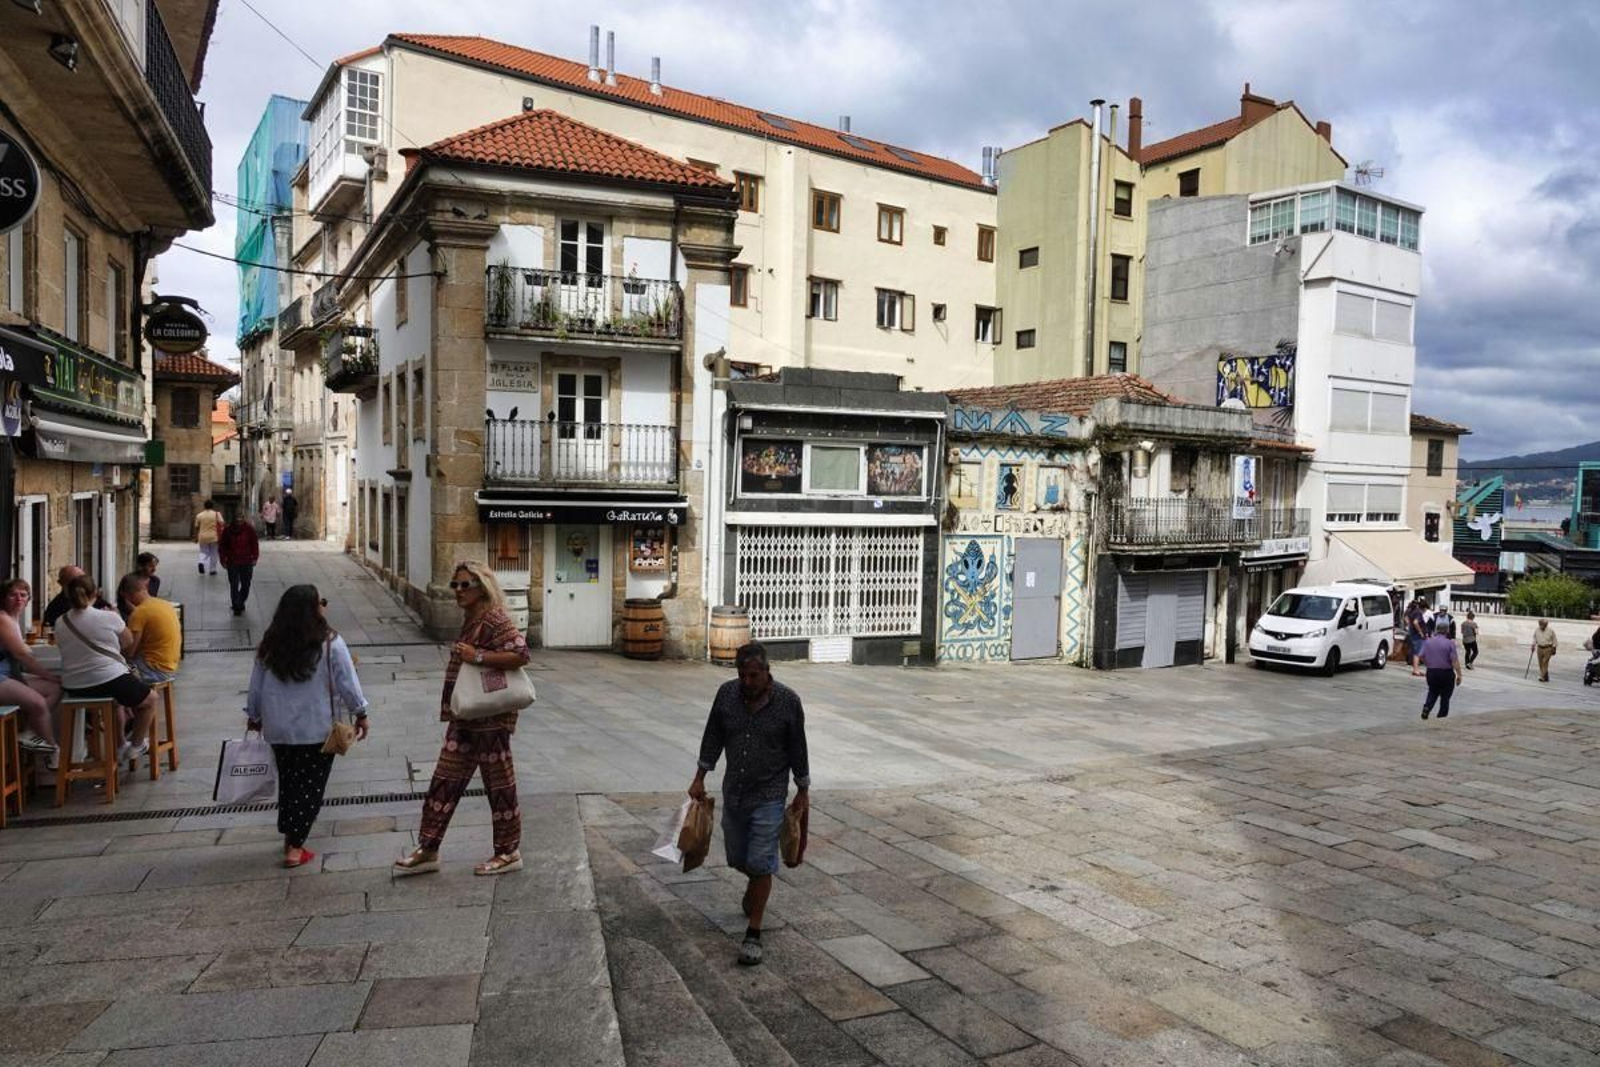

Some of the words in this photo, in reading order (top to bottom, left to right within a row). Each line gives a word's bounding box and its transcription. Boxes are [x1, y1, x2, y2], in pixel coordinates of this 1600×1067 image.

[490, 377, 534, 389] IGLESIA
[489, 510, 517, 518] Estrella
[518, 510, 544, 518] Galicia
